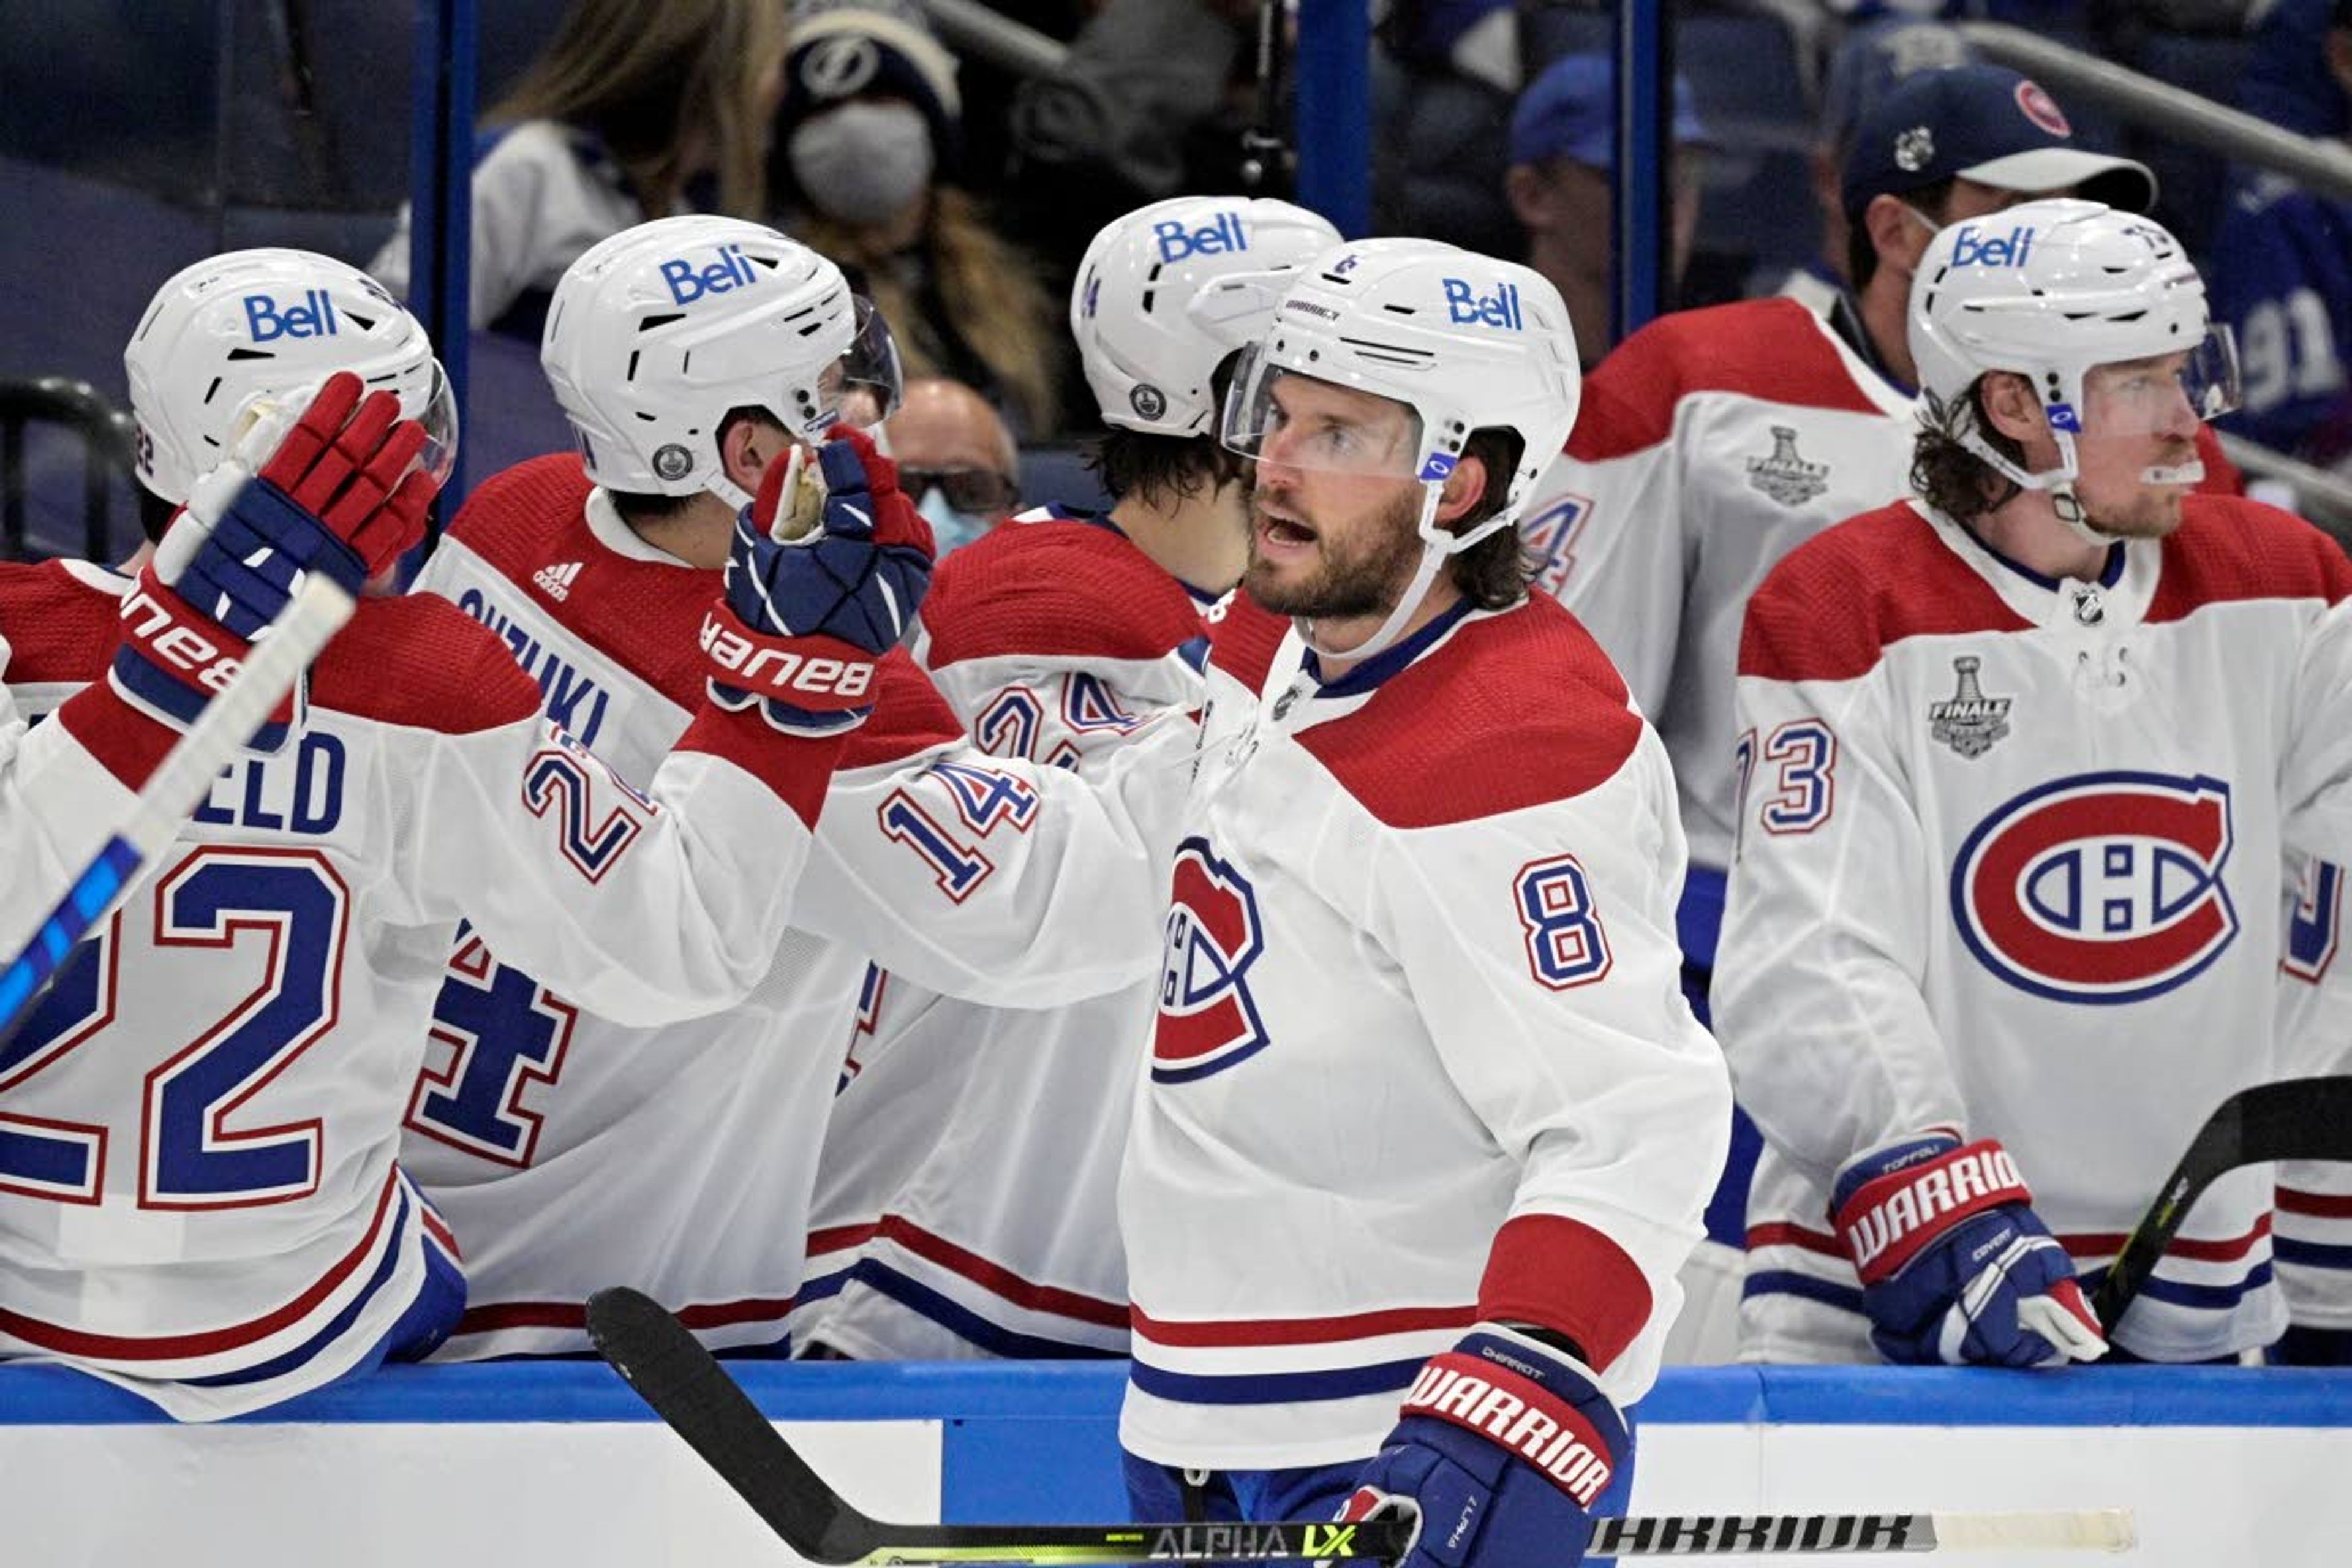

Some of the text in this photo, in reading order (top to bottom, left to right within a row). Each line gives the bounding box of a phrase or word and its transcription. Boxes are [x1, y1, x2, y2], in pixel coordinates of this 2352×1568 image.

[1153, 212, 1248, 263] Bell
[1951, 225, 2035, 268] Bell
[659, 245, 757, 306] Bell
[1443, 277, 1523, 331] Bell
[243, 289, 337, 343] Bell
[2241, 285, 2346, 412] 91
[533, 570, 568, 603] adidas
[1928, 698, 2010, 720] FINALE
[522, 726, 657, 885] 2
[878, 761, 1041, 906] 14
[1513, 853, 1613, 992] 8
[1848, 1150, 2029, 1268] WARRIO
[1401, 1365, 1611, 1506] WARRIOR
[1149, 1525, 1357, 1559] ALPHA LX
